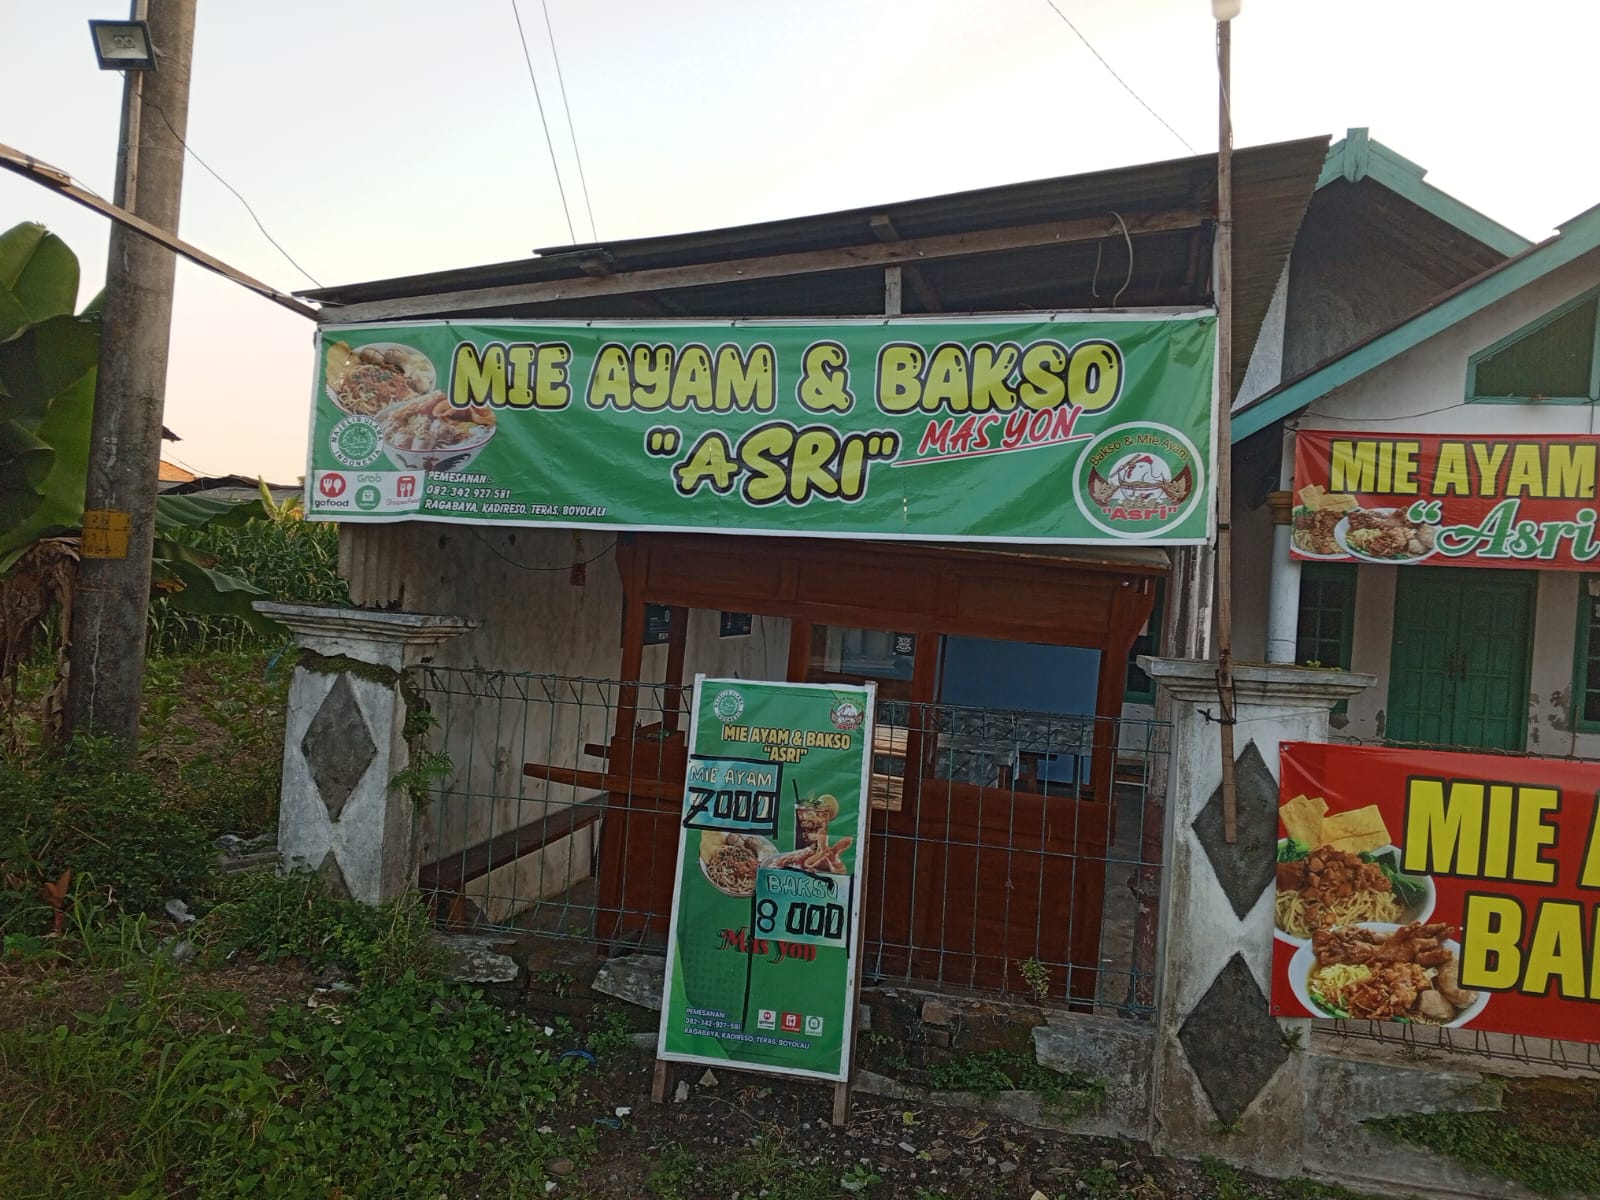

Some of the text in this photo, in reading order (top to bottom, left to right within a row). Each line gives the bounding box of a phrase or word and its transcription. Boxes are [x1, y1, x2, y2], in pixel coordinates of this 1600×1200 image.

[450, 340, 1122, 414] MIE AYAM & BAKSO
[919, 405, 1083, 454] MAS YON
[1089, 434, 1190, 466] Bakso & Mie Ayam
[1329, 438, 1598, 499] MIE AYAM
[314, 499, 349, 509] gofood
[426, 486, 446, 496] 082
[472, 488, 491, 498] 927
[493, 489, 511, 499] 581
[562, 505, 607, 516] BOYOLALI
[722, 724, 852, 750] MIE AYAM & BAKSO
[690, 766, 772, 787] MIE AYAM
[1401, 775, 1562, 890] MIE
[767, 874, 838, 899] BAKSO
